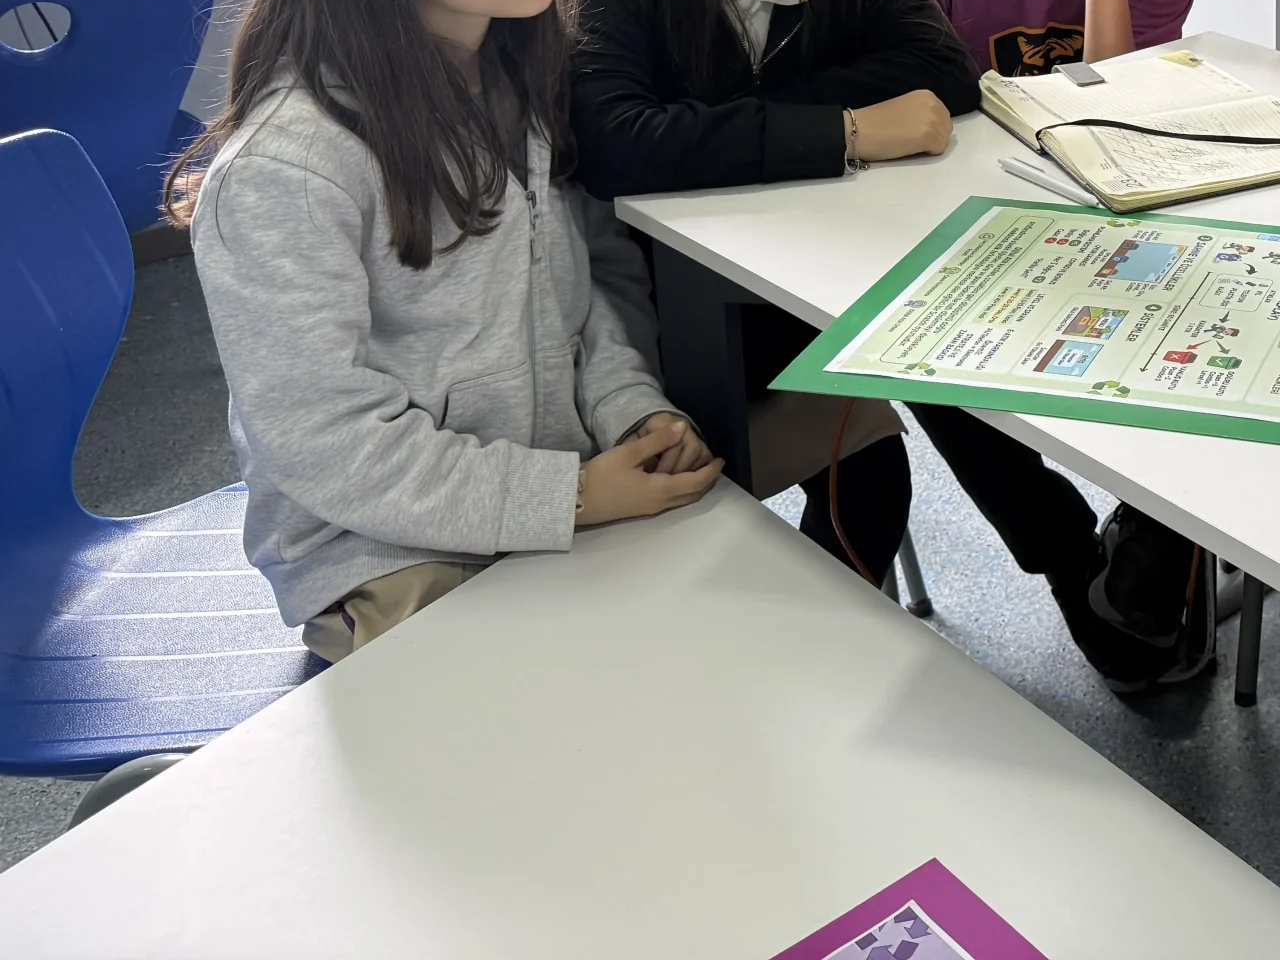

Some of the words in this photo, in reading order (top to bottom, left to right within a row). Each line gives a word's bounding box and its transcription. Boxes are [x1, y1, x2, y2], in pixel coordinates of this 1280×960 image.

[1188, 242, 1205, 256] SAHNE
[1162, 263, 1191, 290] ÖZELLİKLER
[1126, 312, 1154, 341] SİSTEMLER
[1204, 371, 1216, 383] Combo
